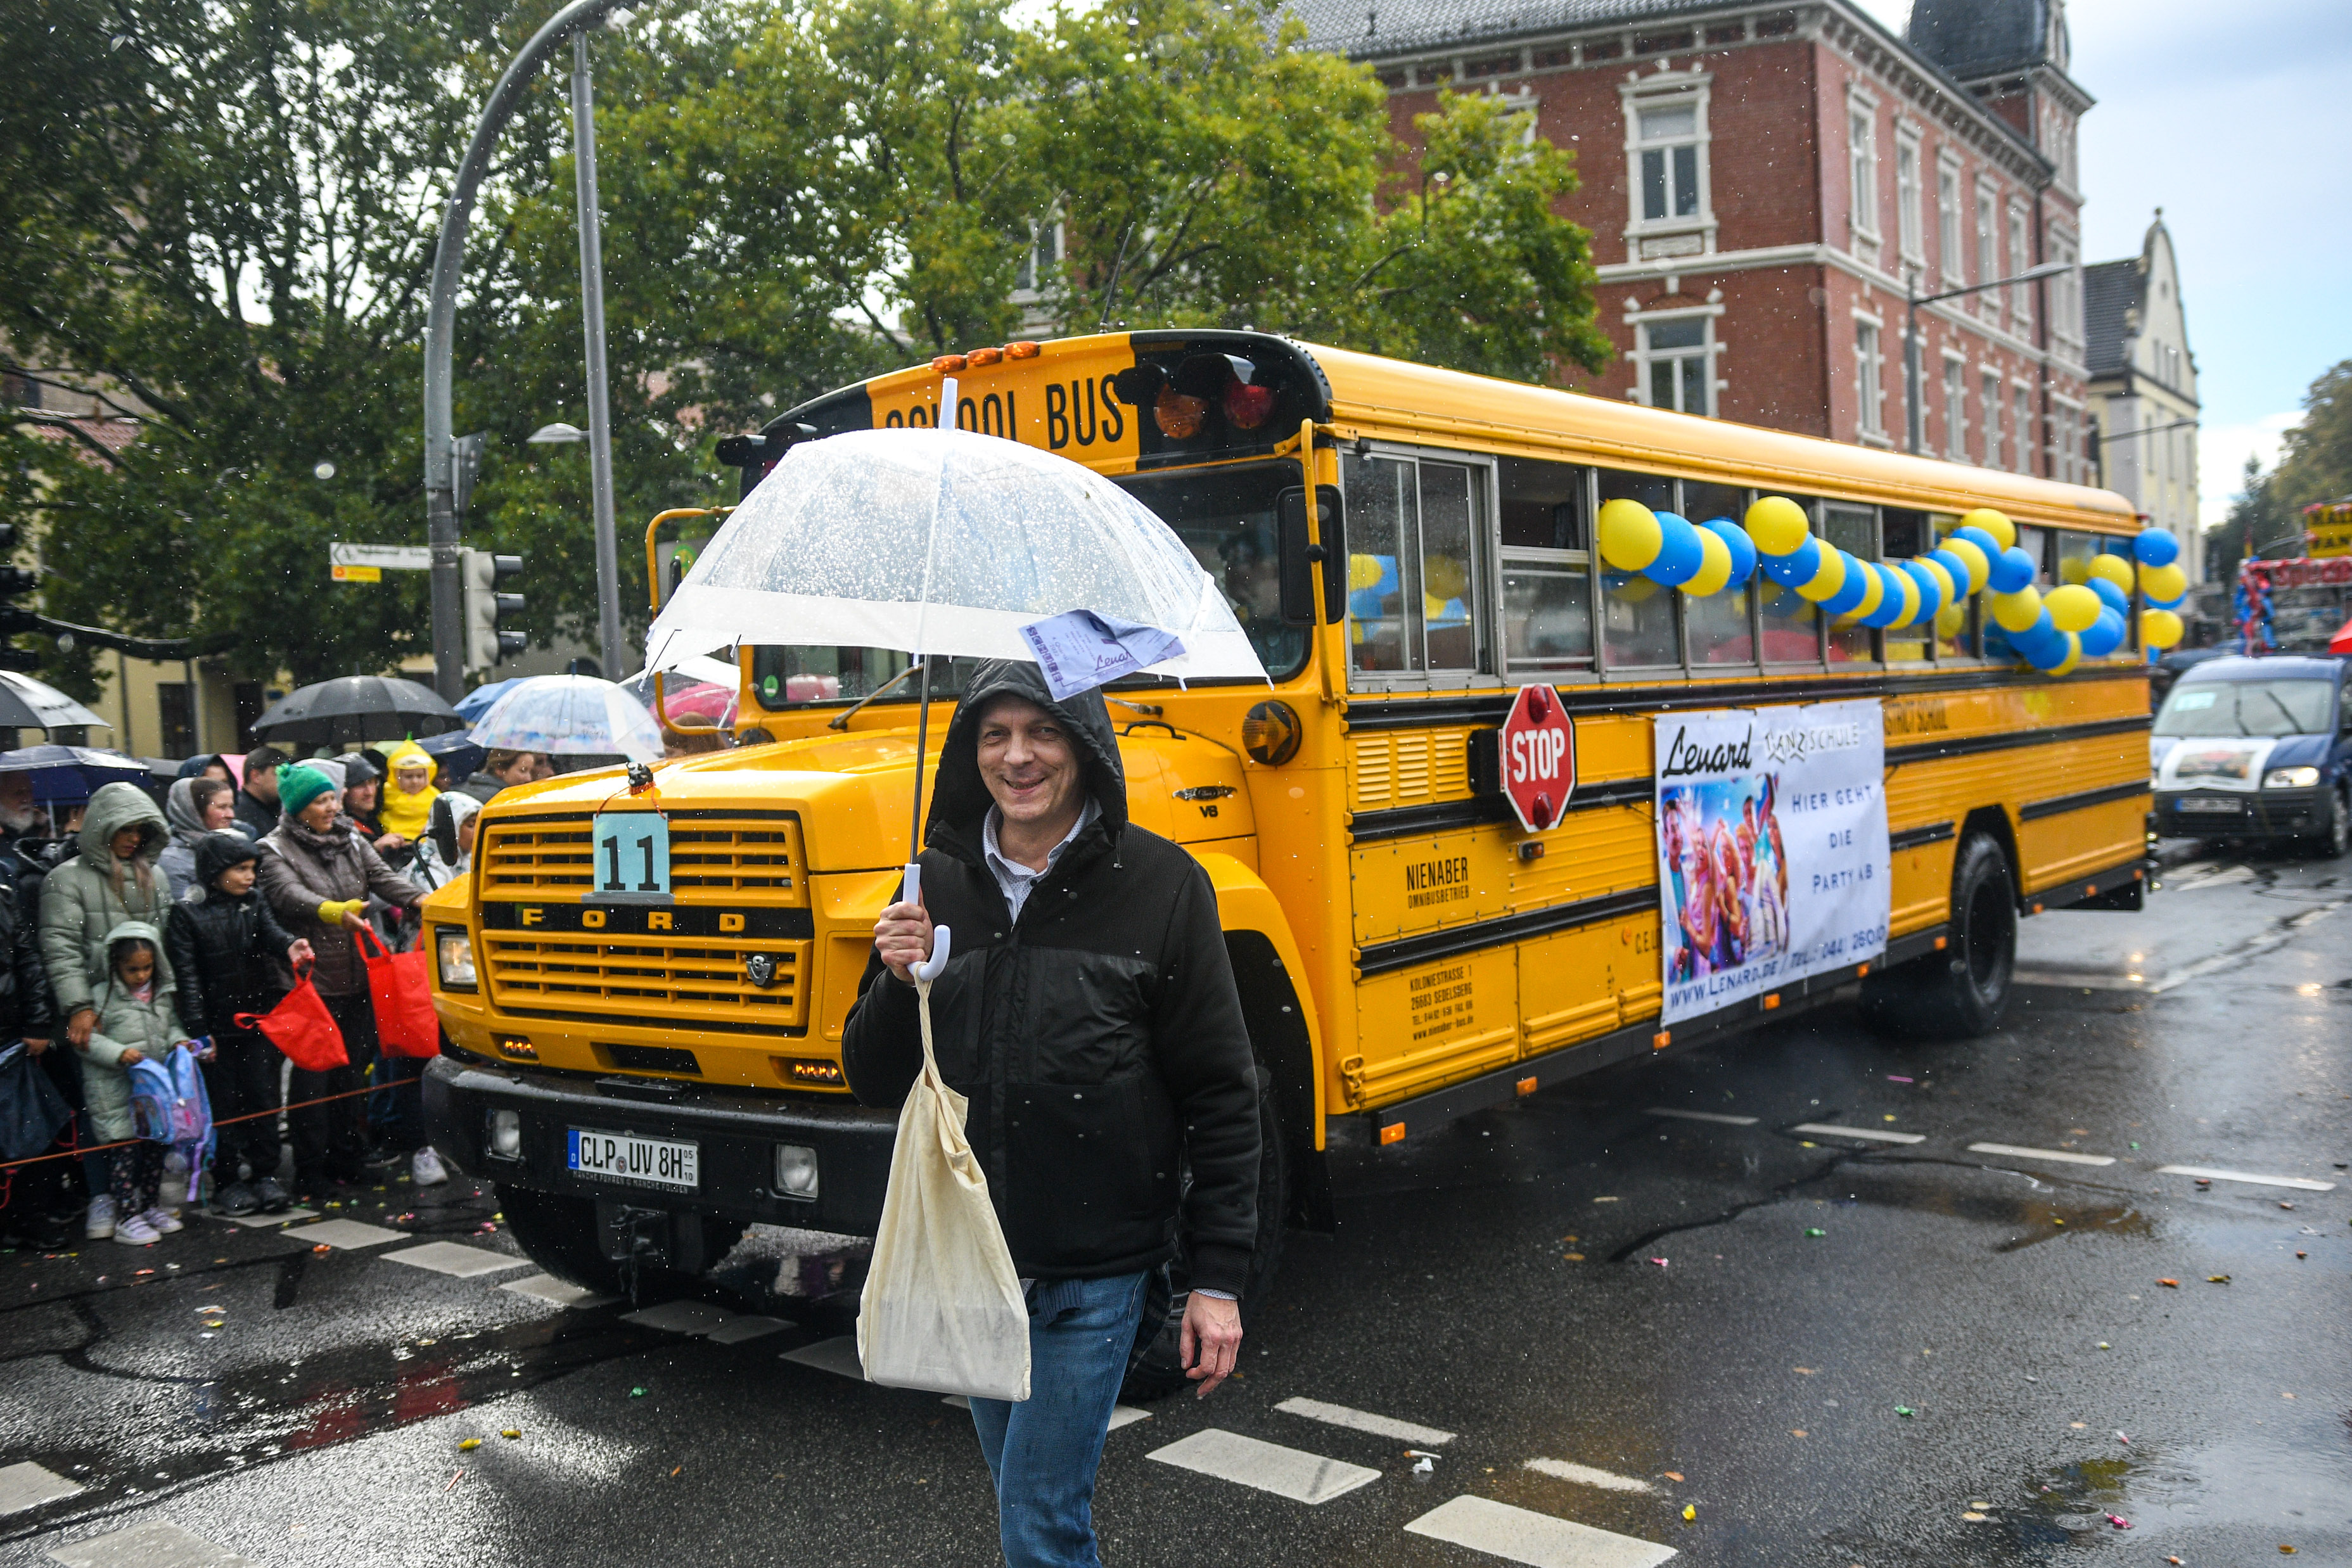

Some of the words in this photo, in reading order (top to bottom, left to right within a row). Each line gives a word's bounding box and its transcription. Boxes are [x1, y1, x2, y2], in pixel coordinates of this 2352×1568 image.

[1046, 373, 1123, 450] BUS
[1026, 626, 1063, 682] SCHULE
[1512, 727, 1566, 783] STOP
[1662, 723, 1753, 779] Lenard
[1199, 805, 1219, 819] V8
[1792, 792, 1828, 813] HIER
[1836, 785, 1872, 805] GEHT
[1829, 829, 1852, 849] DIE
[602, 834, 660, 891] 11
[1407, 857, 1469, 891] NIENABER
[1813, 868, 1854, 894] PARTY
[1859, 863, 1873, 881] AB
[1408, 885, 1470, 909] OMNIBUSBETRIEB
[522, 908, 746, 933] FORD
[1410, 966, 1464, 992] KOLONIESTRASSE
[1411, 992, 1432, 1010] 26683
[1434, 982, 1473, 1004] SEDELSBERG
[580, 1136, 616, 1170] CLP
[629, 1142, 653, 1175] UV
[658, 1146, 682, 1180] 8H
[683, 1149, 693, 1159] 05
[573, 1170, 598, 1182] MANCHE
[633, 1178, 660, 1190] MANCHE
[684, 1171, 694, 1182] 10
